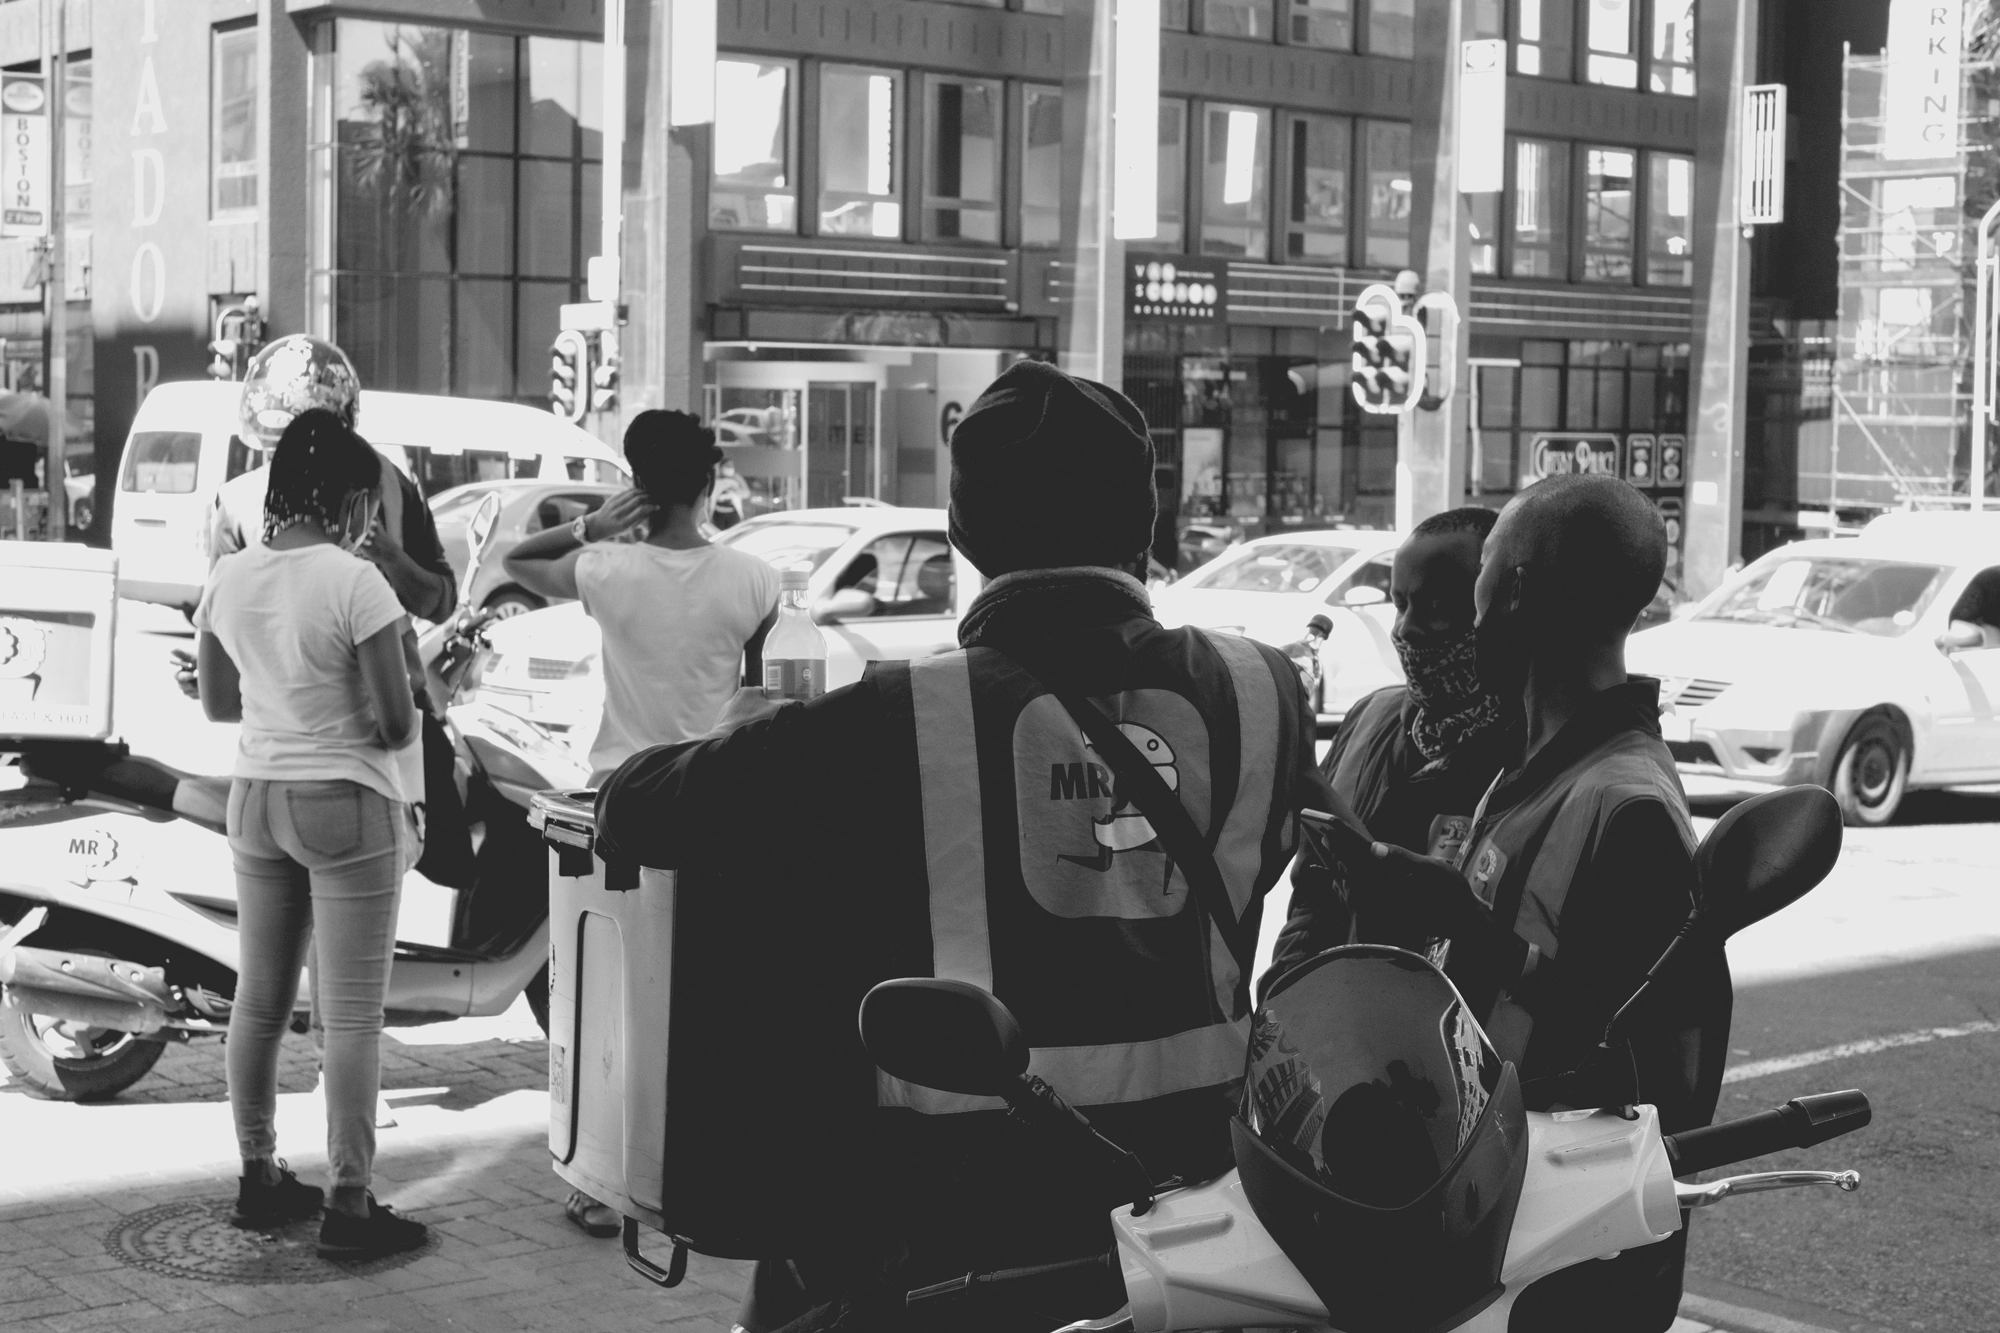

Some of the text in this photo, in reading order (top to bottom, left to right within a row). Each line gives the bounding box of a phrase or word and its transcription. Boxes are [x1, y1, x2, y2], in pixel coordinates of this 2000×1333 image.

[1922, 7, 1948, 143] RKING
[16, 118, 30, 207] BOSTON
[1134, 304, 1214, 318] BOOKSTORE
[1051, 762, 1113, 800] MR
[68, 838, 99, 856] MR
